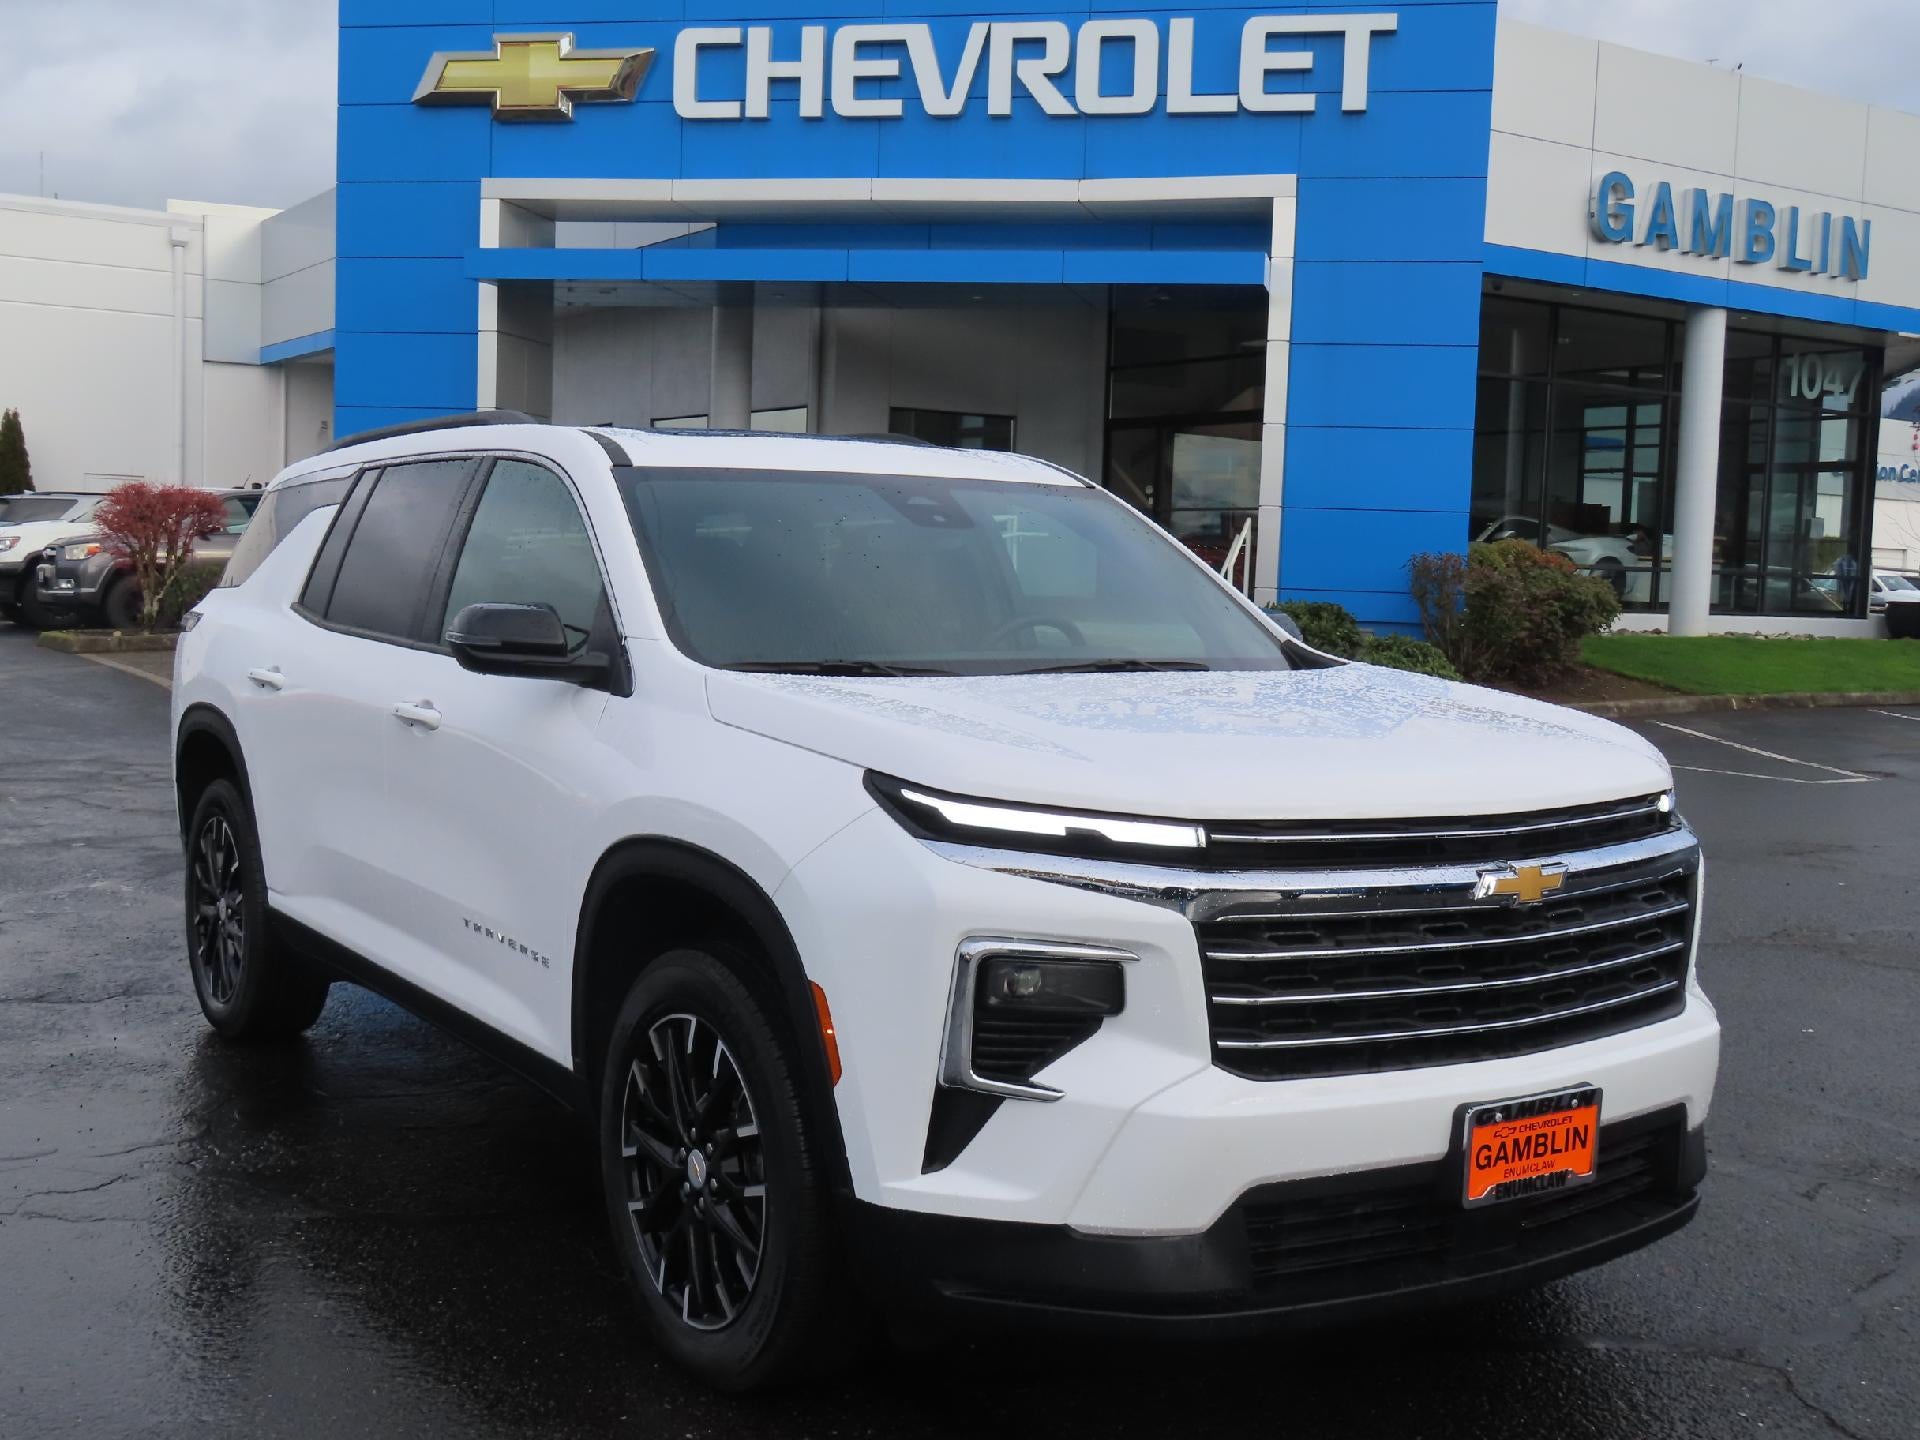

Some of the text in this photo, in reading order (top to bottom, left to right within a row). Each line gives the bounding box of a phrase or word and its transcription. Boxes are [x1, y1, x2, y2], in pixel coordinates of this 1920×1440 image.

[673, 12, 1398, 119] CHEVROLET
[1590, 170, 1871, 281] GAMBLIN
[1788, 351, 1866, 404] 1047
[463, 917, 550, 969] TRAVERSE
[1475, 1124, 1589, 1170] GAMBLIN
[1518, 1115, 1573, 1133] CHEVROLET
[1495, 1168, 1569, 1200] ENUMCLAW
[1503, 1159, 1556, 1179] ENUMCLAW
